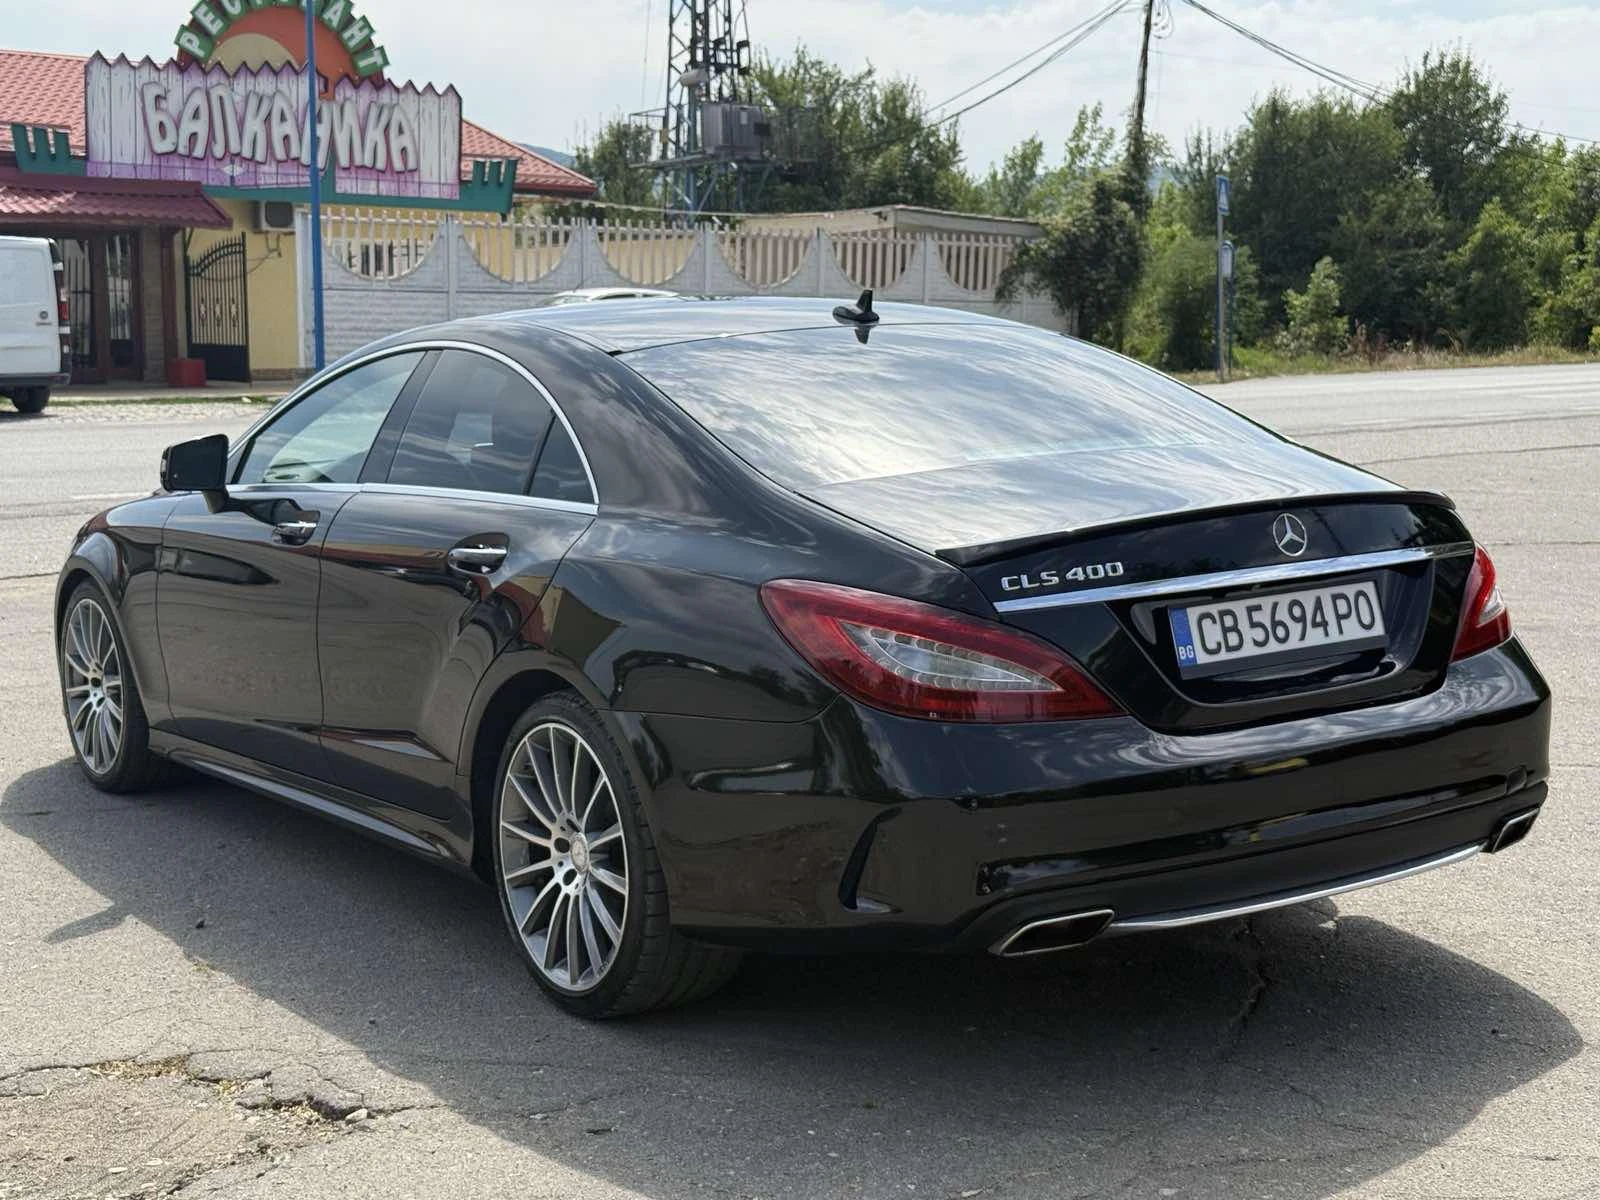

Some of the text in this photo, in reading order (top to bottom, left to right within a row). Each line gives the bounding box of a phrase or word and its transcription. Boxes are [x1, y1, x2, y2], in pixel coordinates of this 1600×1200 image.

[142, 82, 418, 173] БАЛКАНИКА
[1001, 562, 1124, 591] CLS 400
[1178, 645, 1194, 660] BG
